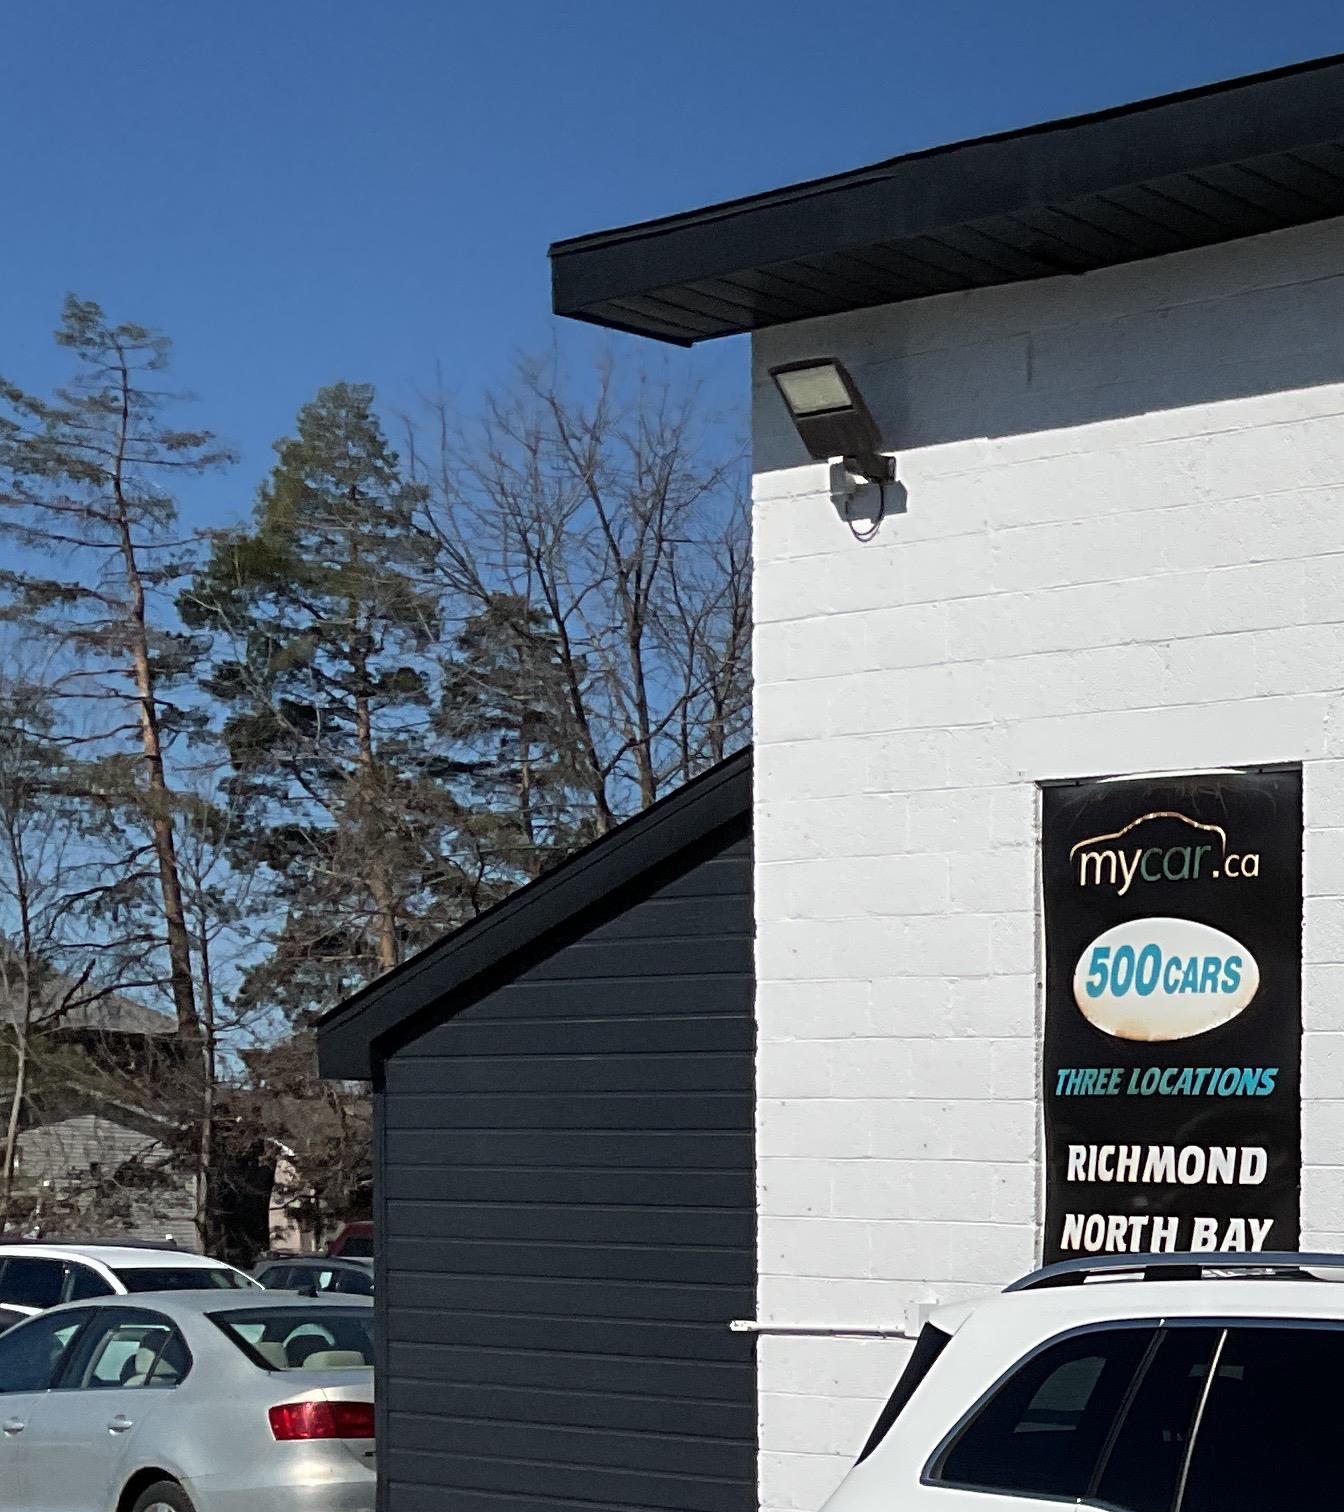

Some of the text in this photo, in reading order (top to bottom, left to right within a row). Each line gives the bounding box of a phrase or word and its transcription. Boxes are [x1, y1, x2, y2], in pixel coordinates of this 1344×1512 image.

[1080, 843, 1260, 896] mycar.ca
[1055, 1066, 1280, 1097] THREE LOCATIONS
[1066, 1144, 1268, 1185] RICHMOND
[1060, 1213, 1275, 1254] NORTH BAY
